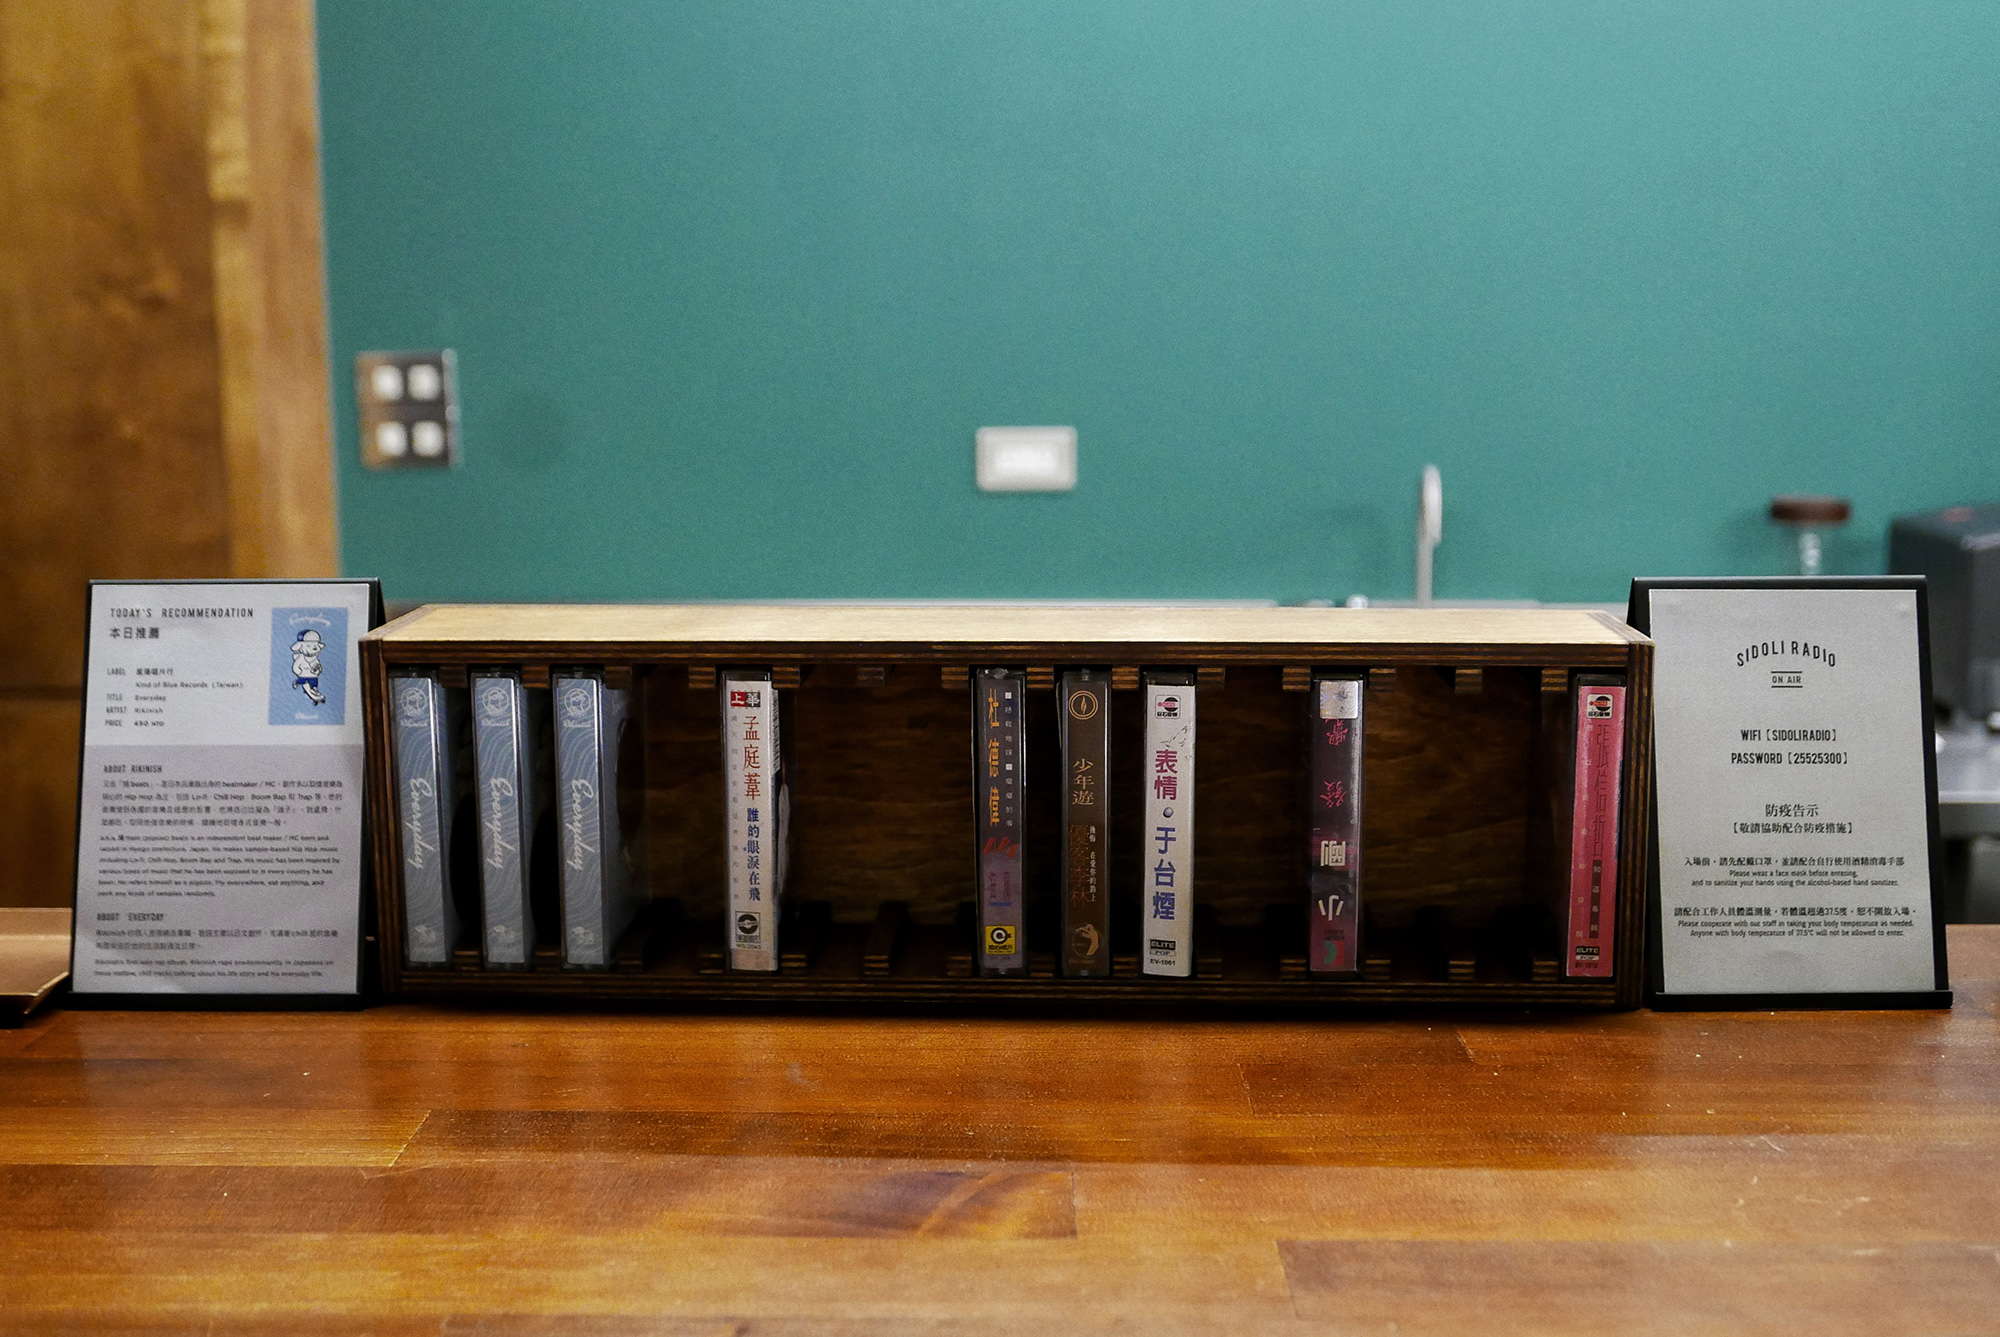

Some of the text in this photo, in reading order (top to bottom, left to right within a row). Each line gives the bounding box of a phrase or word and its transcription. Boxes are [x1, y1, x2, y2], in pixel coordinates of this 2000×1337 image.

[110, 608, 255, 618] TODAY'S RECOMMENDATION
[109, 627, 160, 639] 本日推薦
[1737, 640, 1836, 667] SIDOLI RADIO
[107, 668, 126, 676] LABEL
[1772, 676, 1802, 684] ON AIR
[104, 720, 122, 728] PRICE
[1740, 729, 1762, 741] WIFI
[742, 715, 761, 800] 孟庭葦
[1731, 752, 1783, 765] PASSWORD
[1072, 758, 1095, 806] 少年遊
[1765, 803, 1819, 817] 防疫告示
[405, 778, 434, 869] Everyday
[484, 777, 516, 868] Everyday
[565, 779, 595, 870] Everyday
[1152, 749, 1178, 920] 表情 于台煙
[747, 807, 761, 902] 誰的眼淚在飛
[1318, 840, 1346, 921] 小剛
[1713, 880, 1738, 888] sanitize
[1739, 880, 1754, 888] your
[1754, 880, 1775, 888] hands
[1776, 880, 1794, 888] using
[1808, 880, 1852, 888] alcohol-based
[1852, 880, 1870, 888] hand
[1678, 920, 1699, 928] Please
[1700, 920, 1732, 928] cooperate
[1734, 920, 1749, 928] with
[1762, 920, 1778, 928] staff
[1786, 920, 1806, 928] taking
[1808, 920, 1822, 928] your
[1824, 920, 1840, 928] body
[1840, 920, 1878, 928] temperature
[1690, 930, 1714, 938] Anyone
[1714, 930, 1730, 938] with
[1730, 930, 1746, 938] body
[1748, 930, 1786, 938] temperature
[1850, 930, 1876, 938] allowed
[1151, 940, 1175, 949] ELITE
[1576, 947, 1600, 955] ELITE
